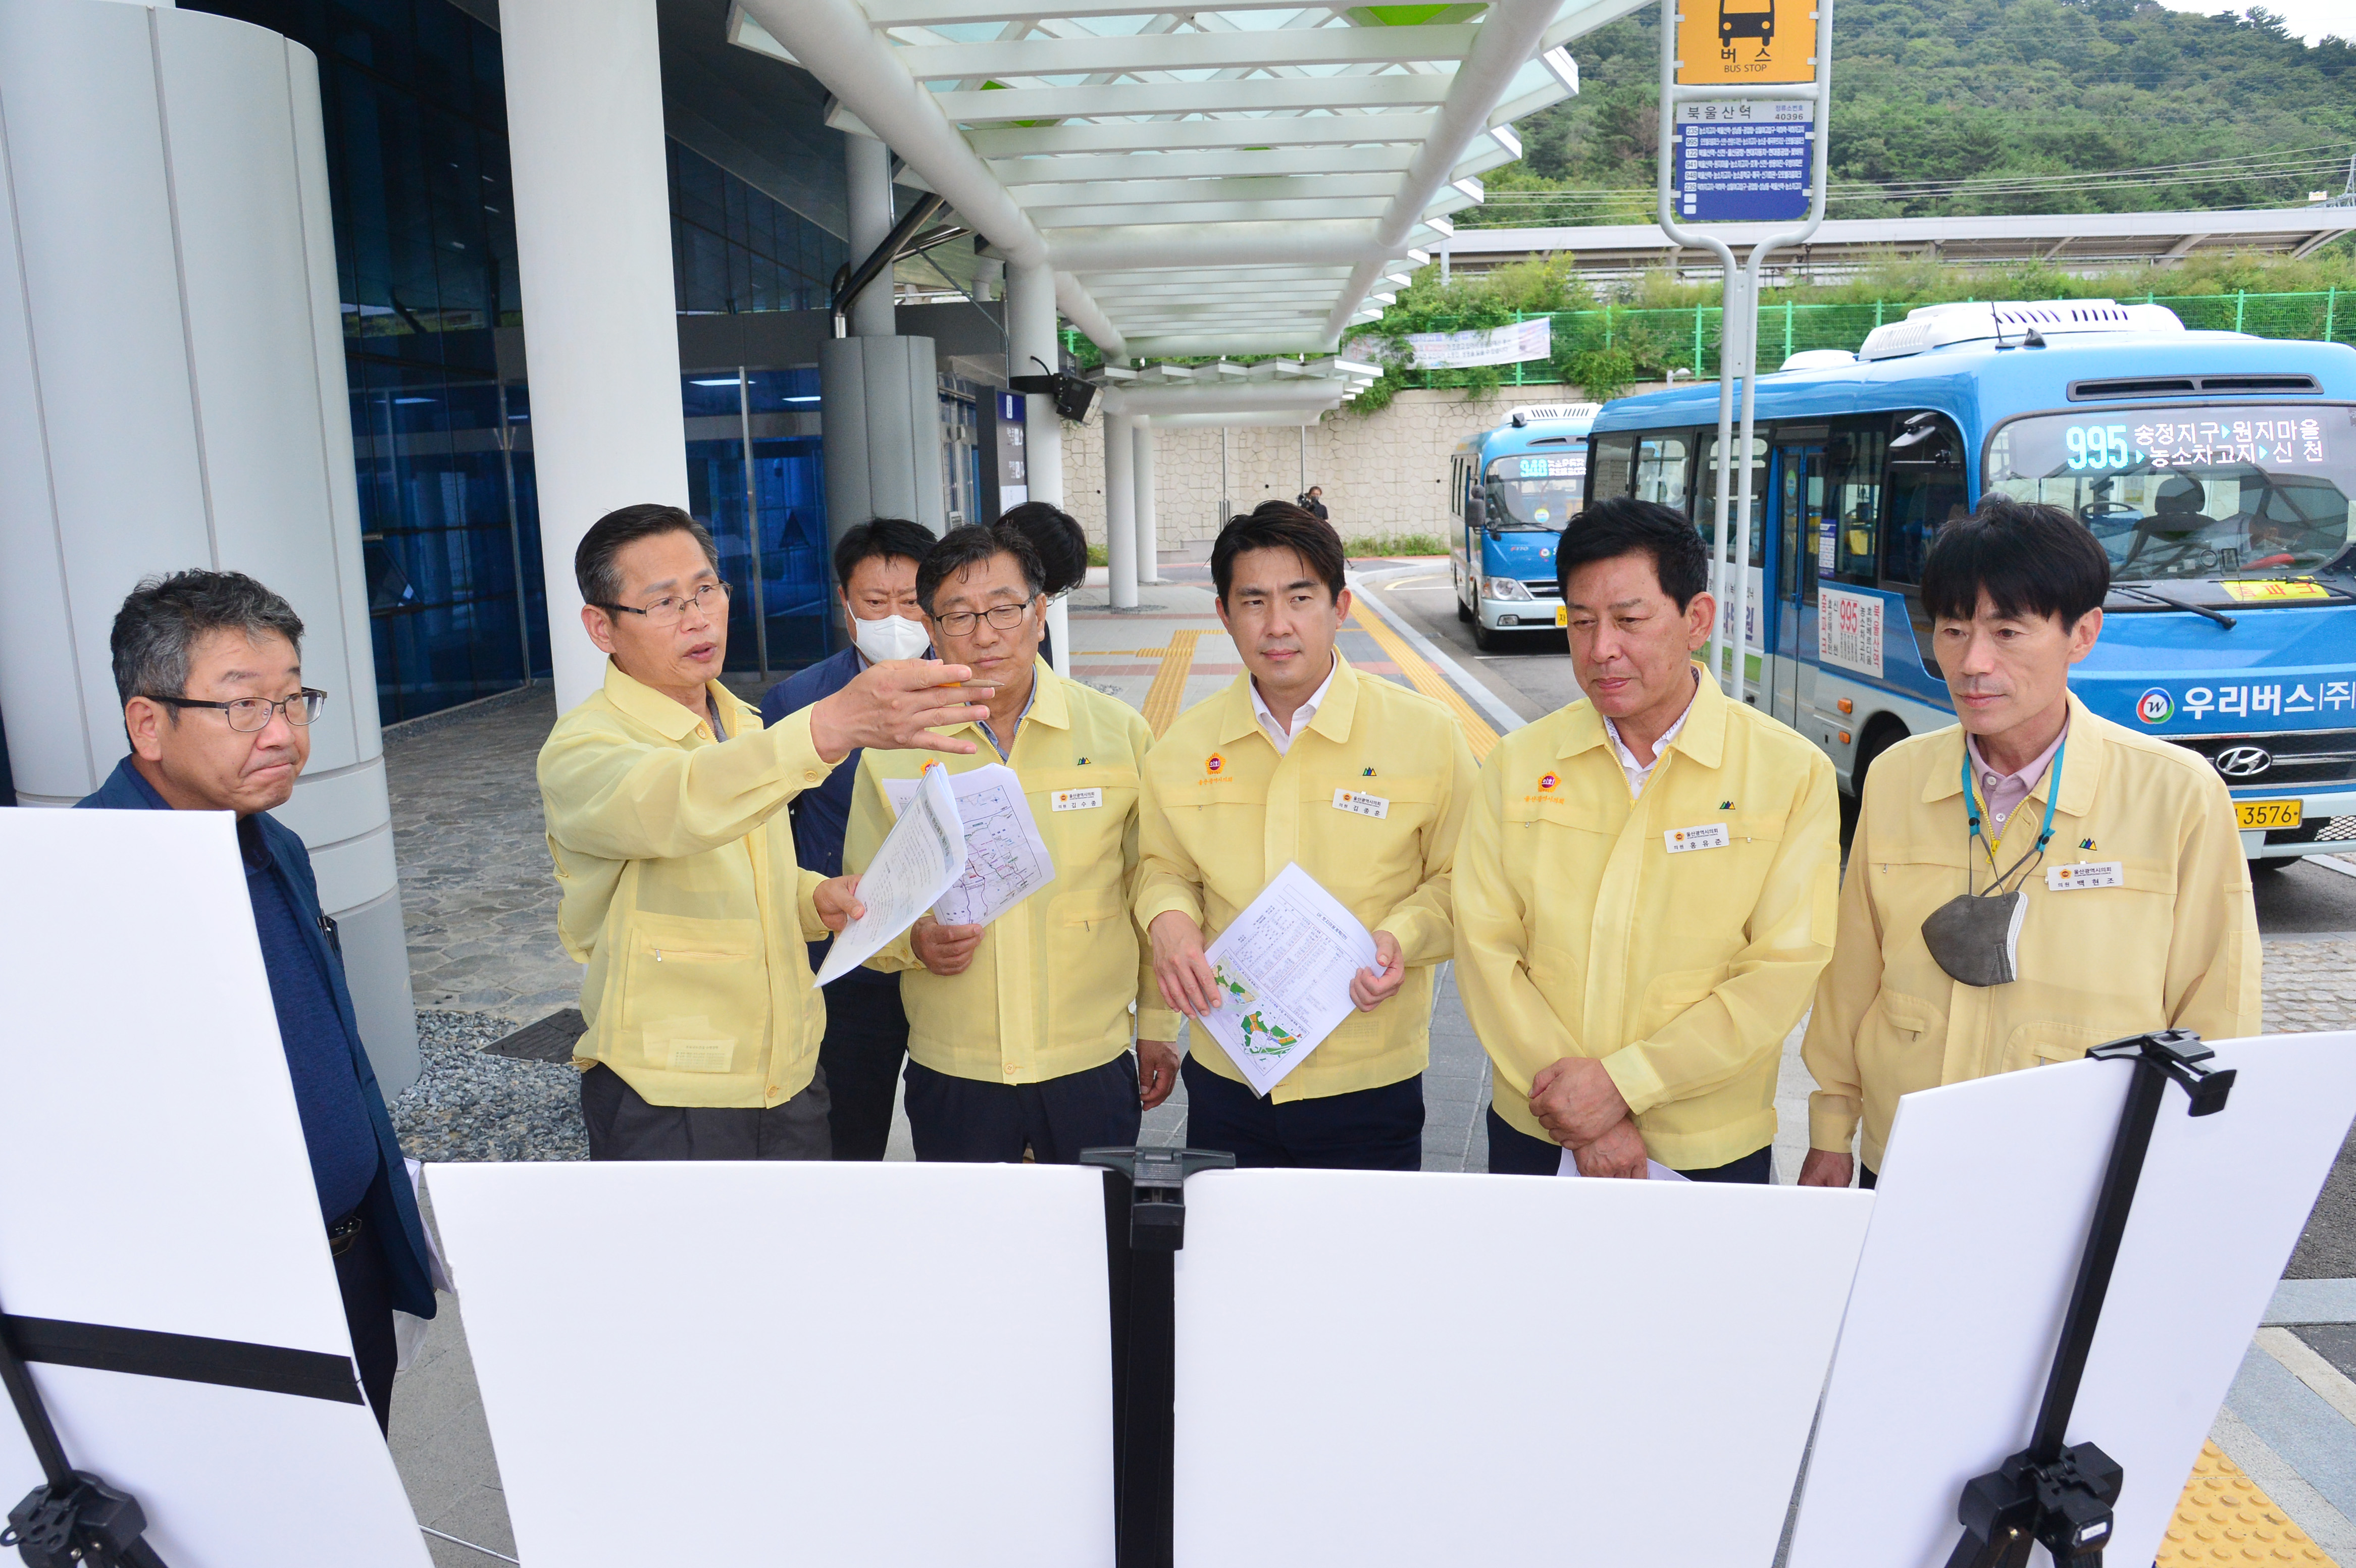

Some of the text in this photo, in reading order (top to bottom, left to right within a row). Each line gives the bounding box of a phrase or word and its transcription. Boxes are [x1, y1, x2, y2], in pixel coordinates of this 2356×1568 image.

[1724, 64, 1767, 73] BUS STOP
[2066, 419, 2320, 471] 995 송정지구 원지마을
[2149, 443, 2257, 468] 농소차고지
[1840, 599, 1858, 633] 995
[2243, 805, 2292, 824] 3576
[1686, 828, 1718, 837] 울산광역시의회
[2074, 867, 2112, 875] 울산광역시의회
